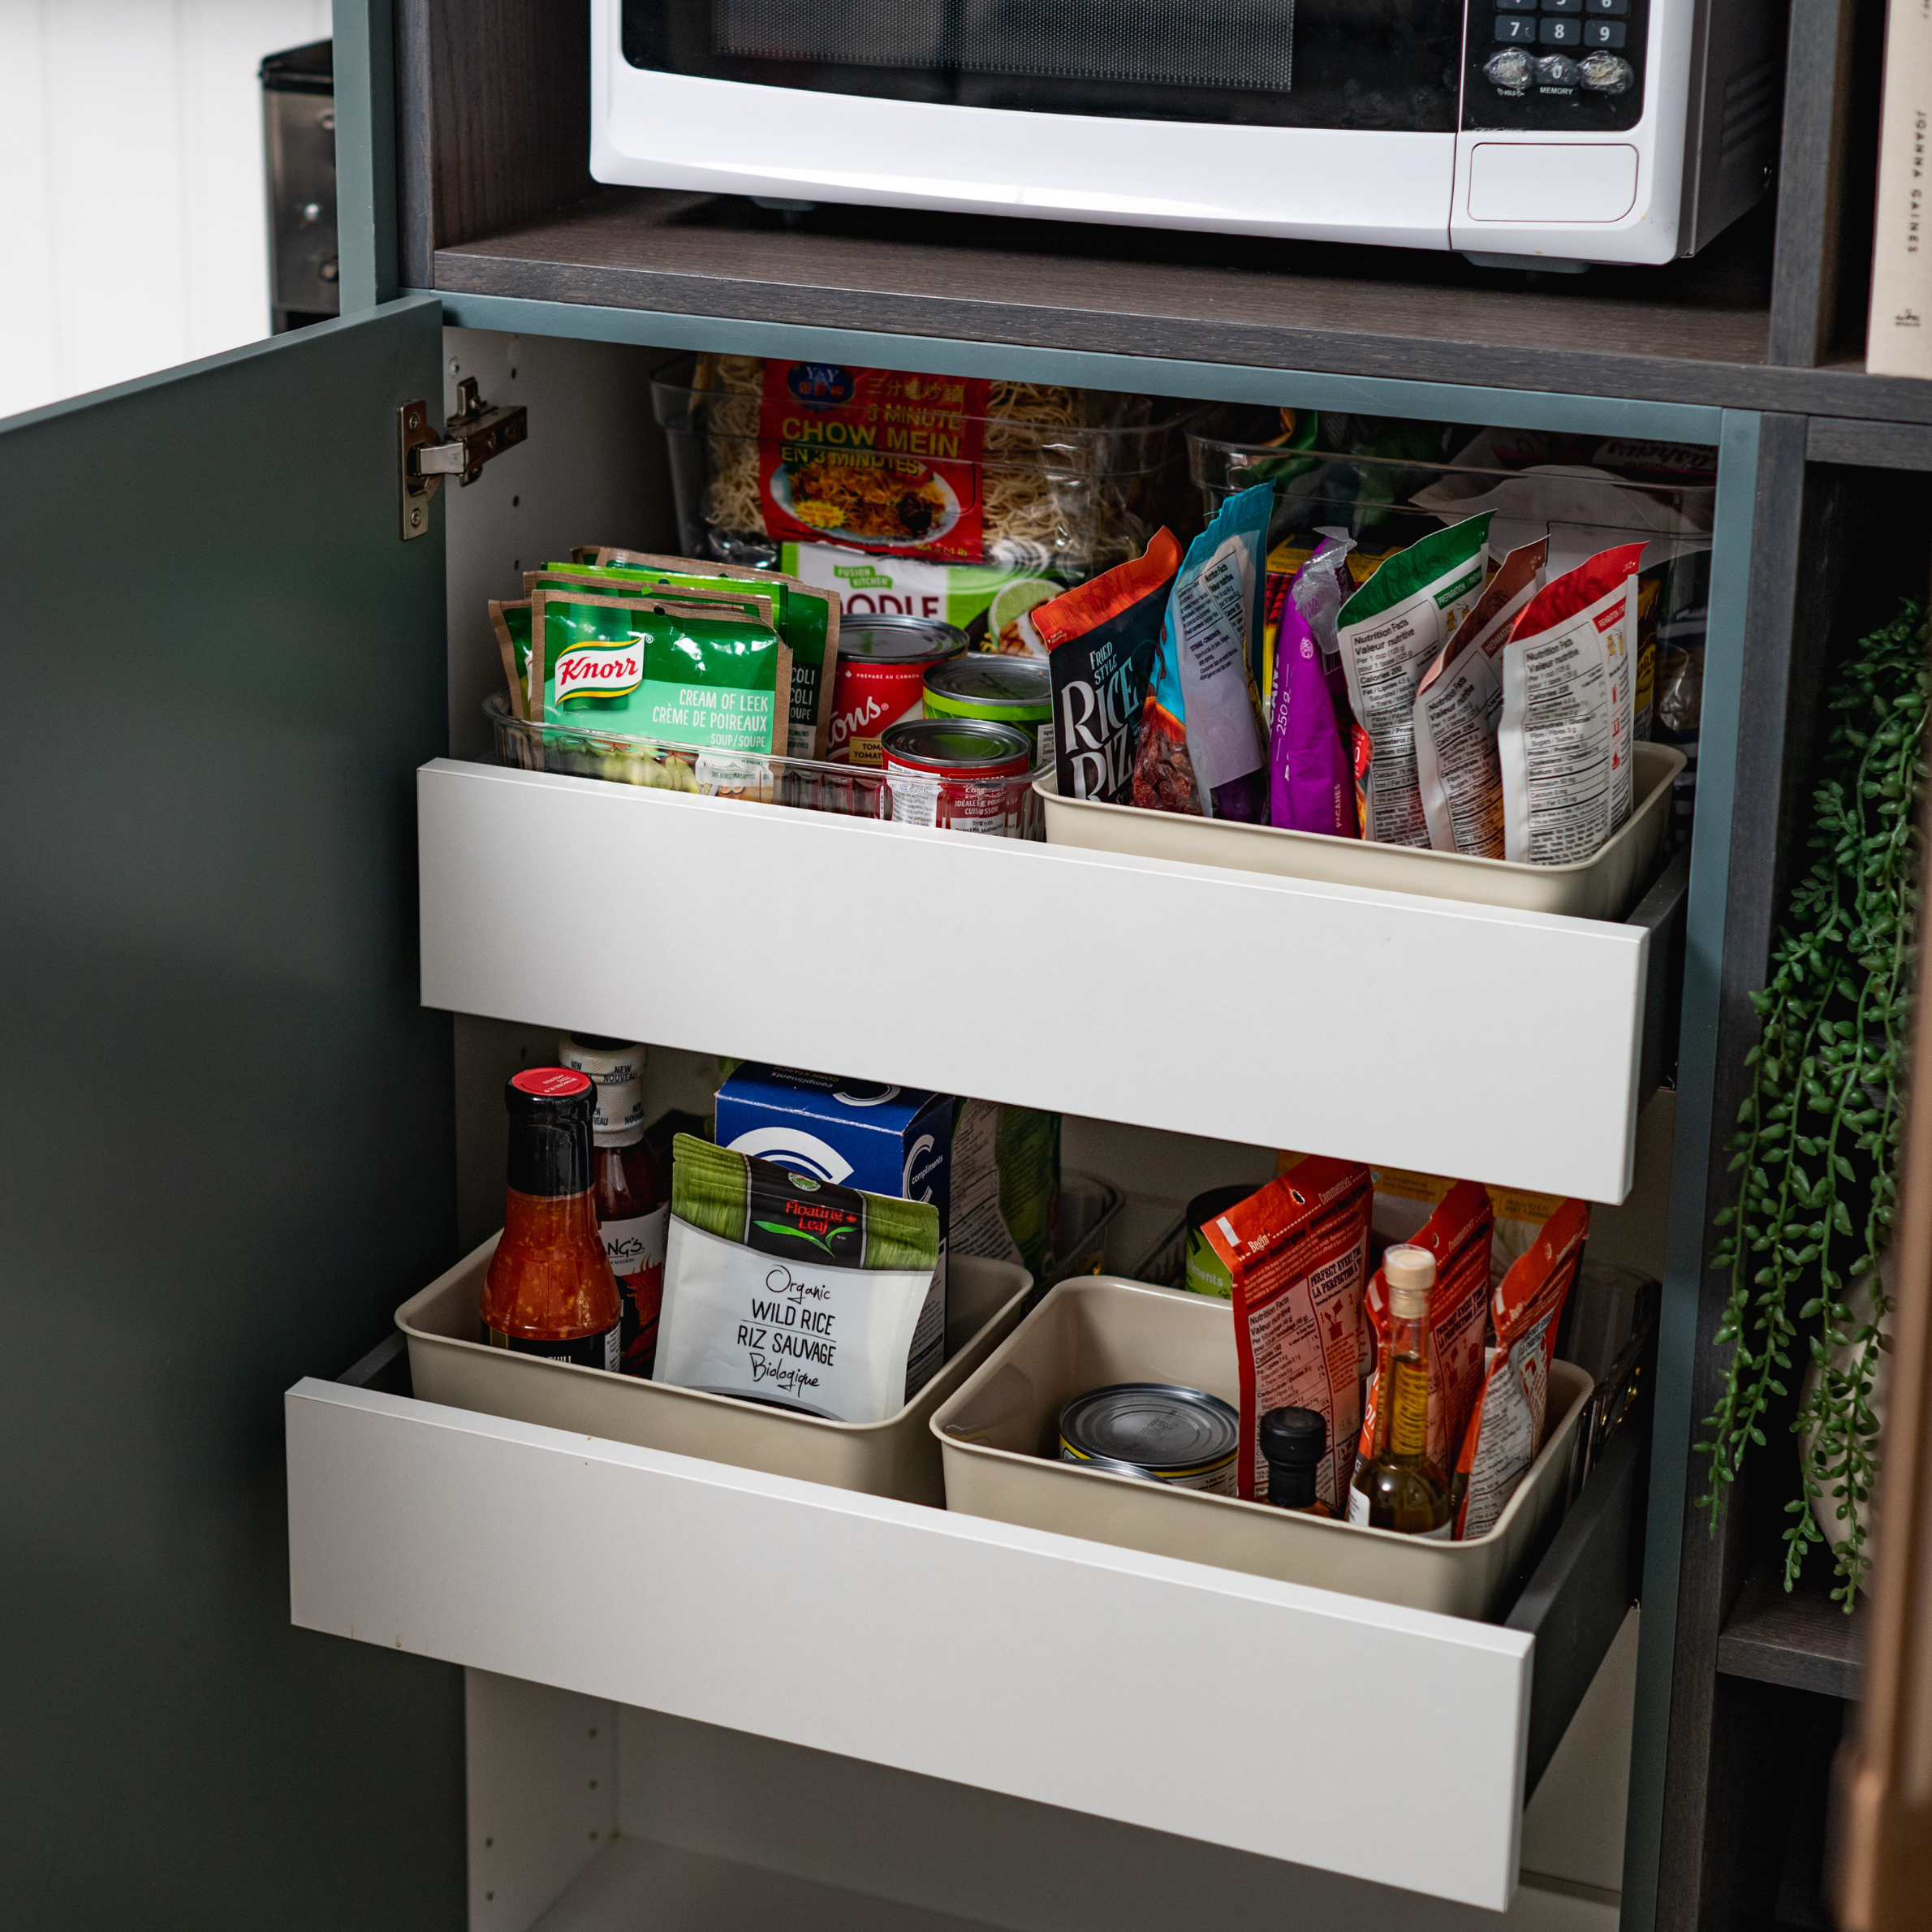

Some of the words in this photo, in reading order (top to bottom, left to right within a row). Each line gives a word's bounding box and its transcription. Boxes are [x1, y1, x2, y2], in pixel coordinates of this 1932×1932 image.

[1510, 22, 1520, 37] 7
[1555, 24, 1565, 39] 8
[1599, 27, 1610, 41] 9
[1552, 64, 1562, 80] 0
[1540, 87, 1573, 96] MEMORY
[1913, 110, 1927, 178] JOANNA
[1908, 188, 1922, 253] GAINES
[867, 403, 878, 422] 3
[885, 403, 964, 432] MINUTE
[782, 416, 877, 447] CHOW
[887, 426, 960, 459] MEIN
[781, 446, 809, 464] EN
[814, 450, 826, 465] 3
[831, 451, 920, 477] MINUTES
[839, 567, 871, 577] FUSION
[853, 577, 888, 587] KITCHEN
[1437, 582, 1467, 606] PREPARATION
[1354, 627, 1393, 645] Nutrition
[1391, 619, 1409, 634] Facts
[1355, 641, 1386, 655] Valeur
[1387, 628, 1415, 647] nutritive
[1356, 657, 1368, 665] Per
[1375, 652, 1387, 662] cup
[1526, 645, 1559, 662] Nutrition
[558, 653, 639, 687] Knorr
[791, 667, 815, 685] COLI
[856, 672, 884, 680] PRÉPARÉ
[1094, 653, 1118, 685] STYLE
[1357, 664, 1373, 675] pour
[1360, 669, 1391, 684] Calories
[1392, 664, 1403, 677] 200
[1527, 658, 1554, 674] Valeur
[679, 689, 716, 708] CREAM
[721, 692, 737, 709] OF
[740, 694, 769, 713] LEEK
[789, 688, 813, 705] COLI
[1362, 687, 1373, 696] Fat
[1528, 690, 1558, 701] Calories
[790, 707, 812, 720] OUPE
[1060, 656, 1140, 755] RICE
[1276, 705, 1289, 735] 250
[1283, 690, 1292, 704] g
[652, 703, 689, 724] CRÈME
[692, 711, 707, 727] DE
[710, 714, 767, 732] POIREAUX
[710, 733, 766, 748] SOUP/SOUPE
[1374, 738, 1407, 748] holesterol
[854, 752, 882, 760] TOMAT
[1374, 748, 1395, 757] odium
[1070, 723, 1134, 803] RIZ
[1529, 769, 1552, 777] Sodium
[1373, 771, 1397, 780] Calcium
[1334, 783, 1342, 828] PACANES
[571, 1059, 583, 1071] NEW
[615, 1064, 632, 1074] NEW
[603, 1072, 638, 1083] NOUVEAU
[770, 1071, 834, 1089] compliments
[812, 1072, 839, 1083] CORN
[593, 1107, 602, 1116] EW
[593, 1117, 609, 1127] VEAU
[911, 1154, 943, 1185] compliments
[785, 1200, 844, 1223] Floating
[1248, 1235, 1270, 1253] Begin
[1318, 1177, 1352, 1205] Commencez
[798, 1216, 830, 1236] Leaf
[606, 1237, 645, 1258] NG'S
[766, 1264, 830, 1305] Organic
[1310, 1263, 1337, 1287] PERFECT
[1312, 1287, 1322, 1299] LA
[1321, 1265, 1355, 1294] PERFECTION
[752, 1298, 796, 1326] WILD
[800, 1309, 836, 1336] RICE
[1249, 1305, 1275, 1326] Nutrition
[1275, 1296, 1290, 1310] Facts
[1251, 1321, 1271, 1336] Valeur
[737, 1325, 767, 1350] RIZ
[771, 1332, 837, 1367] SAUVAGE
[749, 1352, 820, 1398] Biologique
